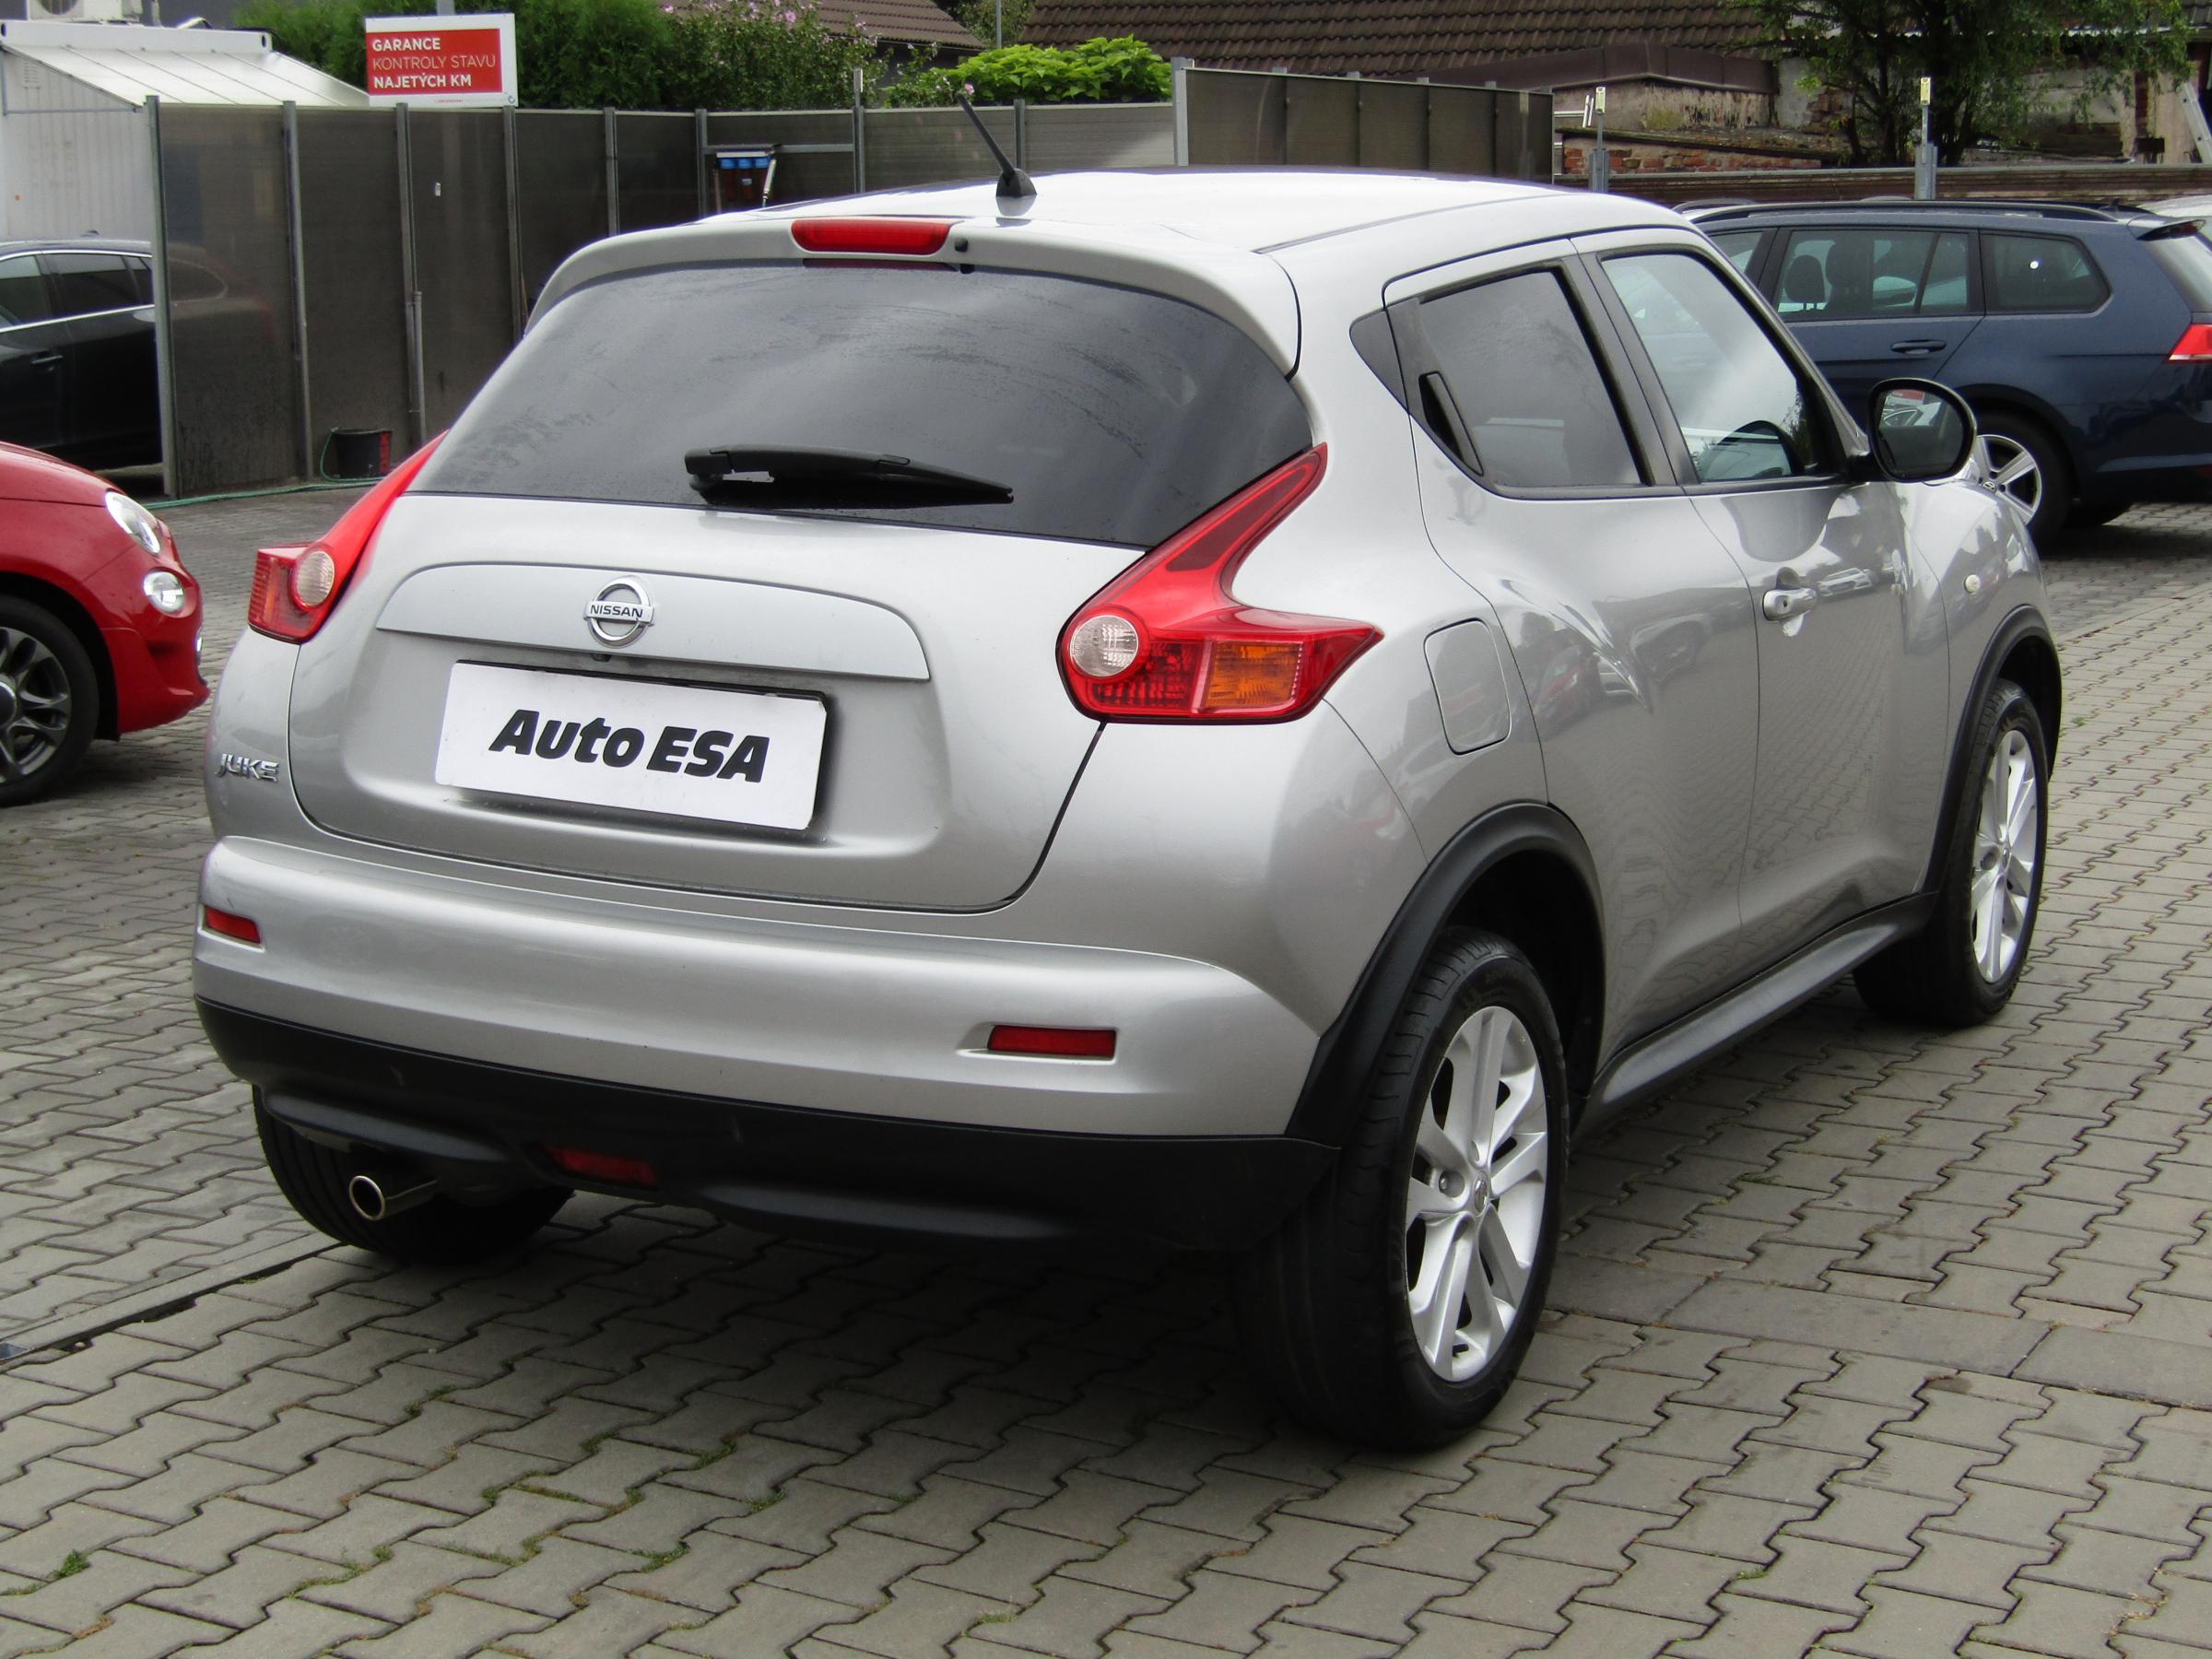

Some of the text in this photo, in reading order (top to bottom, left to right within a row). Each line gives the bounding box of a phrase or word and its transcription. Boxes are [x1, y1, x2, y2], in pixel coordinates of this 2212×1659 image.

[372, 37, 441, 52] GARANCE
[372, 54, 496, 70] KONTROLY STAVU
[373, 73, 472, 88] NAJETÝCH KM
[590, 604, 643, 618] NISSAN
[488, 709, 770, 783] Auto ESA
[216, 753, 278, 782] JUKE
